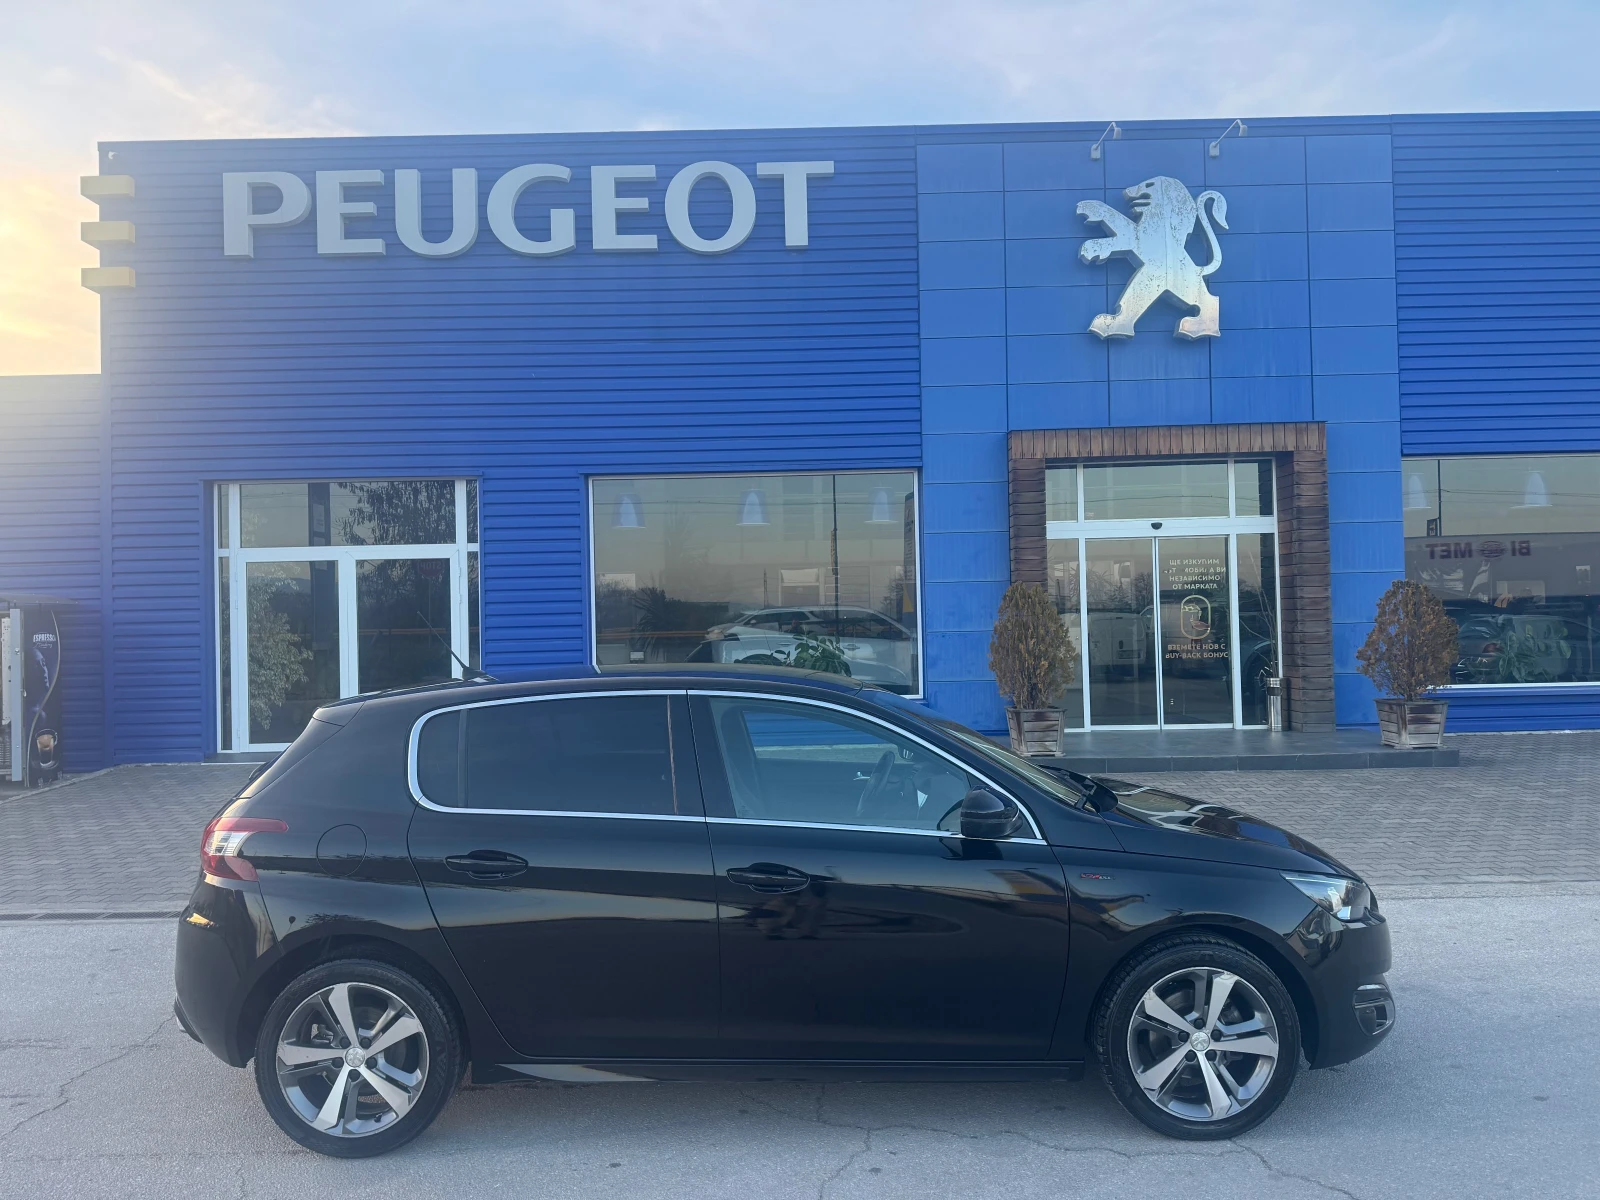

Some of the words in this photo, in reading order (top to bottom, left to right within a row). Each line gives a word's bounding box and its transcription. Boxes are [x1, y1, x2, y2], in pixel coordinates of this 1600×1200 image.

[222, 160, 835, 258] PEUGEOT
[1169, 574, 1221, 582] НЕЗАВИСИМО
[1167, 643, 1201, 651] ВЗЕМЕТЕ
